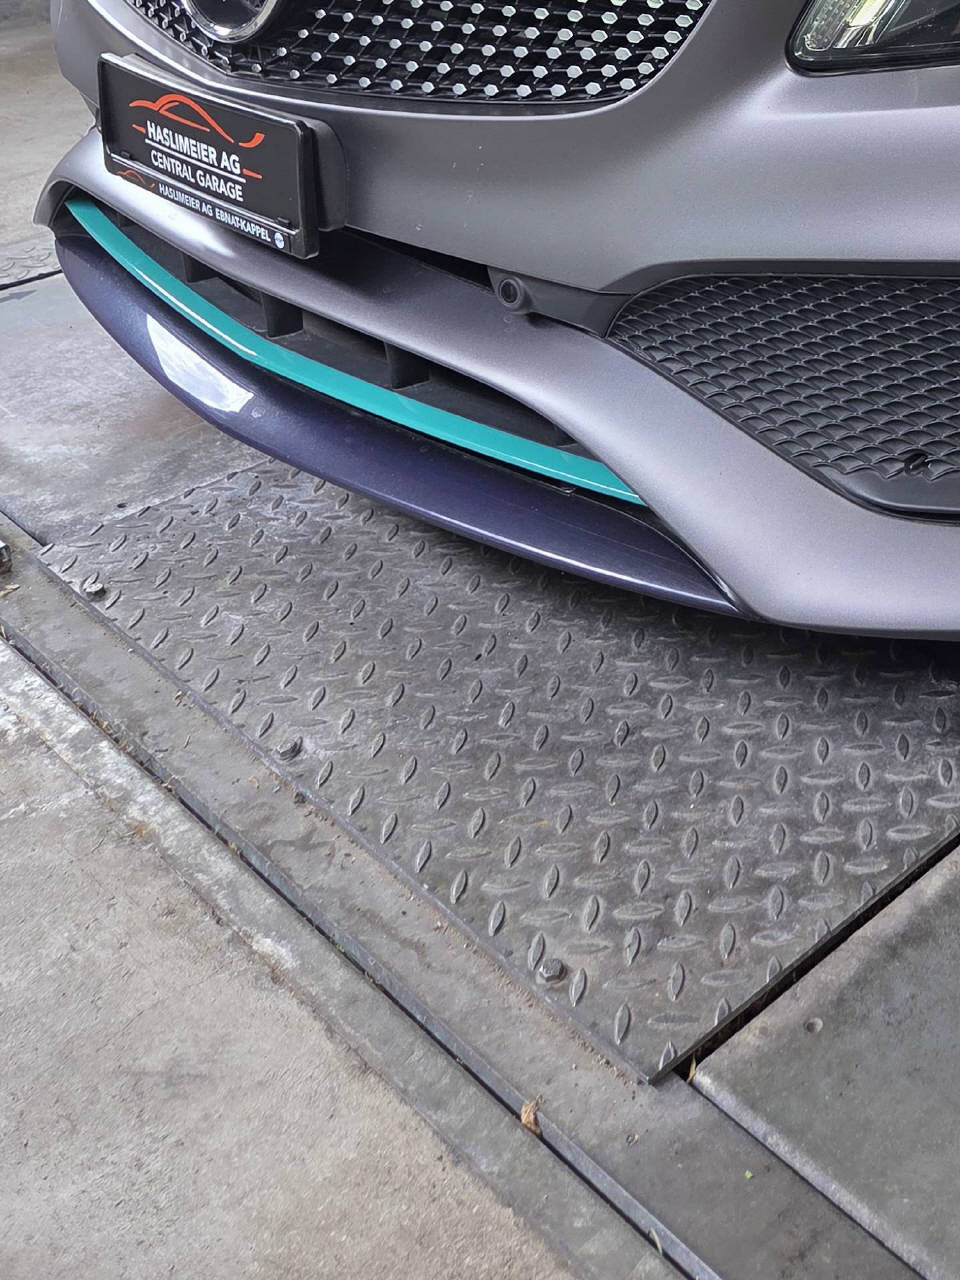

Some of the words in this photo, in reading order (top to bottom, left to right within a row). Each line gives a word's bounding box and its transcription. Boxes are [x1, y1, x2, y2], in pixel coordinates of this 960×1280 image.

[147, 120, 218, 166] HASLIMEIER
[220, 151, 241, 175] AG
[151, 150, 195, 183] CENTRAL
[196, 169, 243, 201] GARAGE
[158, 183, 201, 212] HASLIMEIER
[201, 201, 214, 217] AG
[215, 208, 271, 242] EBNAT-KAPPEL
